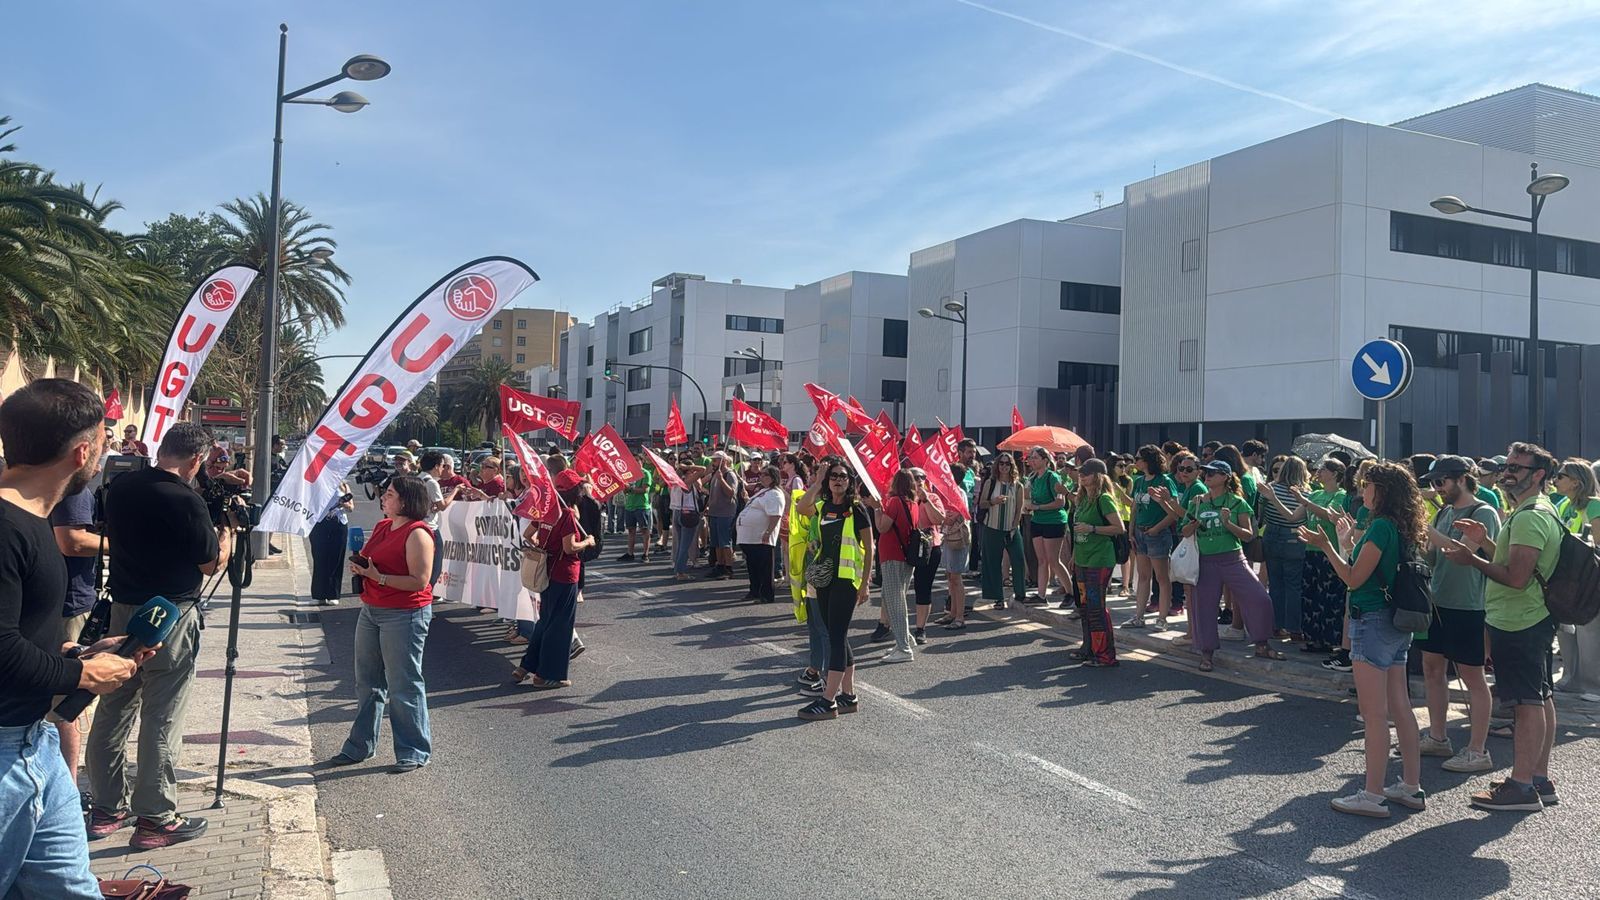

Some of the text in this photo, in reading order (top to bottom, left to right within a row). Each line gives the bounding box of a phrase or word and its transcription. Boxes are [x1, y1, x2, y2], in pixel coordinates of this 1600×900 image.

[153, 314, 217, 443] UGT
[304, 312, 455, 484] UGT
[508, 397, 546, 421] UGT
[592, 433, 620, 457] UGT
